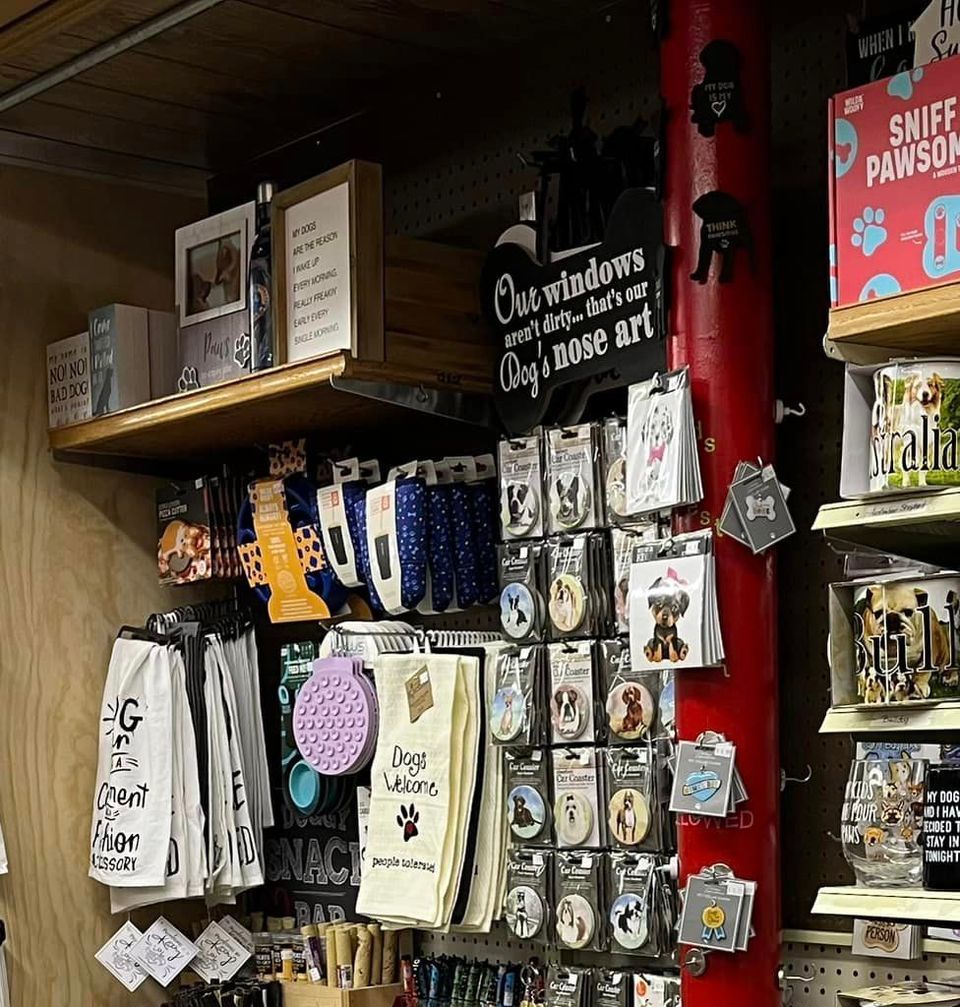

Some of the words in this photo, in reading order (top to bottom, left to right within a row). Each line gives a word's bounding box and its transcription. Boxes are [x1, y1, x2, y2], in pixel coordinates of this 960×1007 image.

[858, 29, 894, 59] WHEN
[889, 96, 957, 149] SNIFF
[301, 221, 317, 235] DOGS
[706, 219, 737, 231] THINK
[494, 273, 542, 324] Our
[542, 247, 645, 306] windows
[504, 319, 540, 349] aren't
[585, 288, 623, 318] that's
[625, 281, 648, 302] our
[500, 341, 549, 399] Dog's
[552, 327, 608, 371] nose
[615, 301, 654, 348] art
[50, 385, 68, 404] BAD
[392, 745, 426, 777] Dogs
[384, 772, 438, 798] Welcome
[940, 790, 960, 803] DOG
[926, 835, 945, 848] STAY
[948, 835, 960, 848] IN
[372, 857, 401, 869] people
[925, 850, 960, 863] TONIGHT
[865, 926, 895, 943] PERSON
